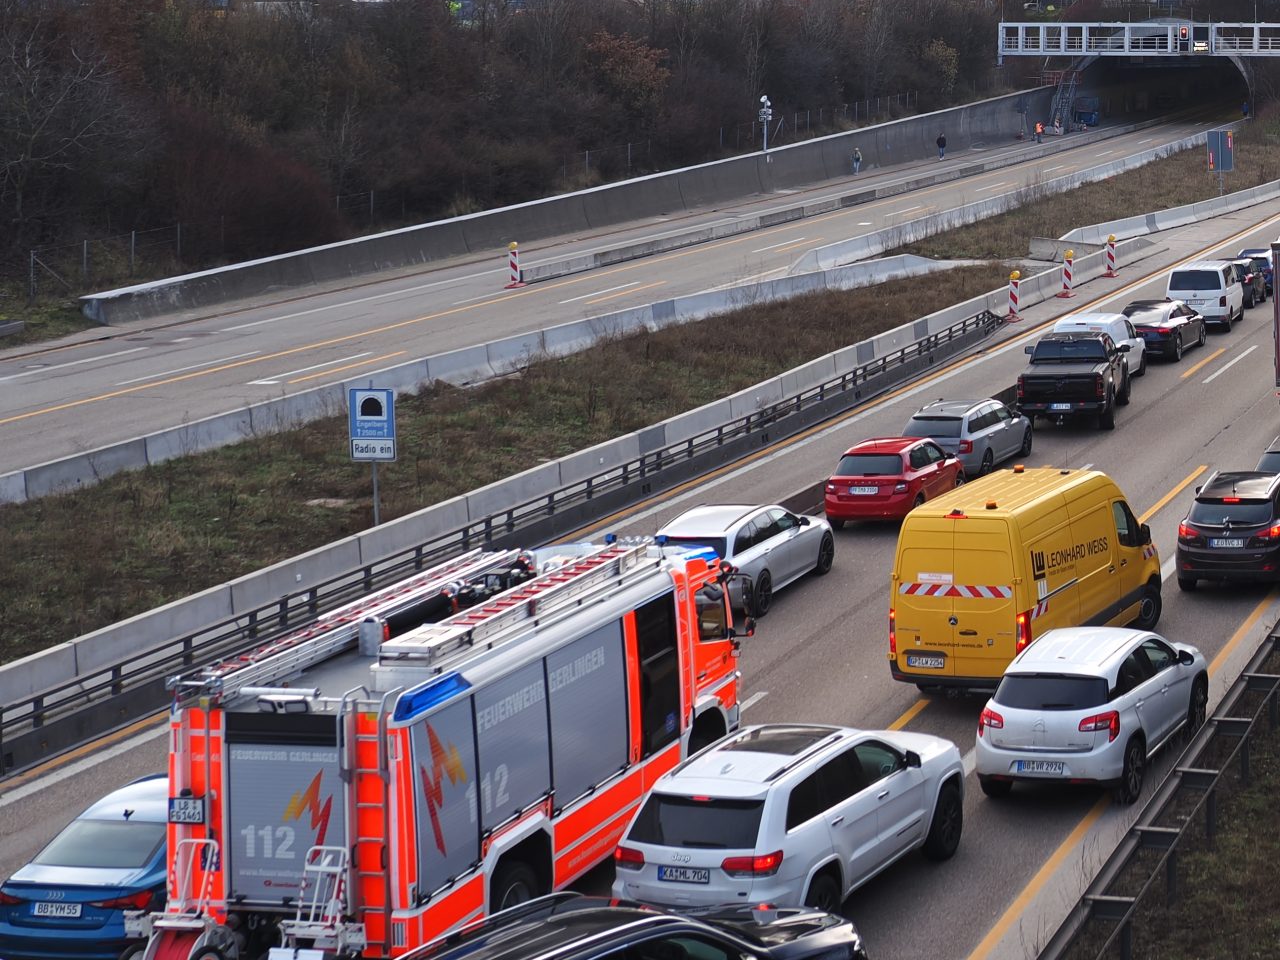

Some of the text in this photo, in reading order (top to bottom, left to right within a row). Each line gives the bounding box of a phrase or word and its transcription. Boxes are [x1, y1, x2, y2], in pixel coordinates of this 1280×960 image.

[356, 421, 387, 429] Engelberg
[355, 444, 391, 454] Radio ein
[1046, 536, 1109, 569] LEONHARD WEISS
[924, 641, 984, 649] www.leonhard-weiss.de
[477, 646, 605, 734] FEUERWEHR GERLINGEN
[231, 750, 288, 761] FEUERWEHR
[465, 763, 510, 824] 112
[241, 824, 295, 859] 112
[671, 852, 692, 863] Jeep
